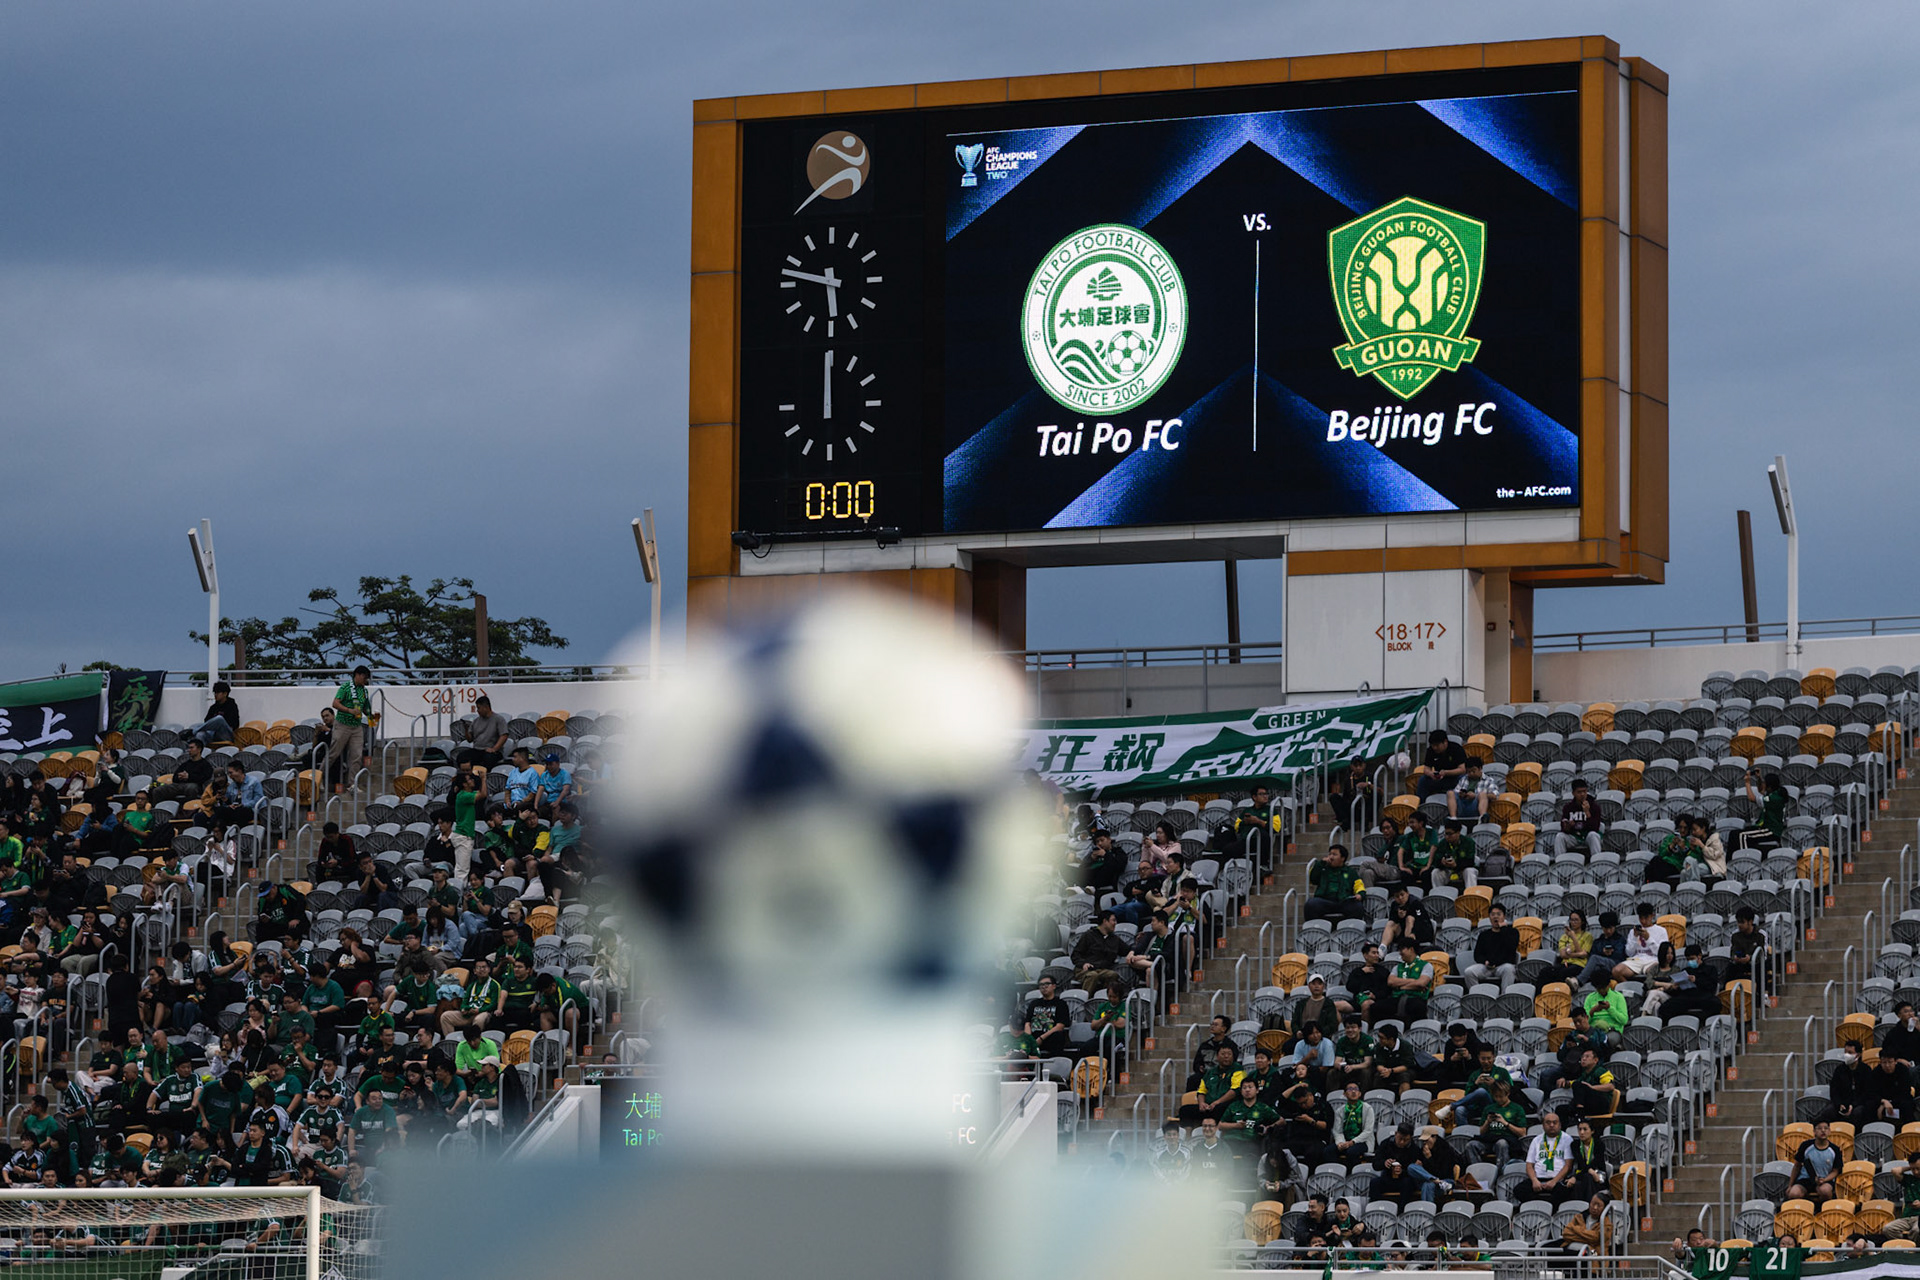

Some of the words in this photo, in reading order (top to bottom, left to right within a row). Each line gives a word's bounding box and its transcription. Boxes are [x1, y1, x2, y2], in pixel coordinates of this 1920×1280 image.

[985, 151, 1037, 162] CHAMPIONS
[985, 161, 1019, 171] LEAGUE
[986, 171, 1008, 180] TWO
[1243, 213, 1271, 231] VS.
[1035, 274, 1053, 297] TAI
[1052, 250, 1071, 272] PO
[1074, 233, 1147, 257] FOOTBALL
[1149, 253, 1176, 293] CLUB
[1351, 260, 1368, 320] BEIJING
[1361, 221, 1405, 257] GUOAN
[1409, 220, 1462, 271] FOOTBALL
[1446, 276, 1463, 315] CLUB
[1059, 303, 1150, 328] 大埔足球會
[1361, 338, 1452, 365] GUOAN
[1391, 368, 1422, 381] 1992
[1065, 384, 1108, 406] SINCE
[1113, 378, 1148, 404] 2002
[1326, 405, 1445, 448] Beijing
[1454, 402, 1496, 436] FC
[1037, 422, 1085, 457] Tai
[1091, 422, 1132, 454] Po
[1142, 418, 1183, 451] FC
[806, 480, 874, 520] 0:00
[1387, 642, 1412, 651] BLOCK
[433, 706, 456, 714] BOCK
[622, 1128, 643, 1146] Tai
[959, 1126, 976, 1145] FC
[1707, 1248, 1729, 1272] 10
[1765, 1247, 1787, 1270] 21
